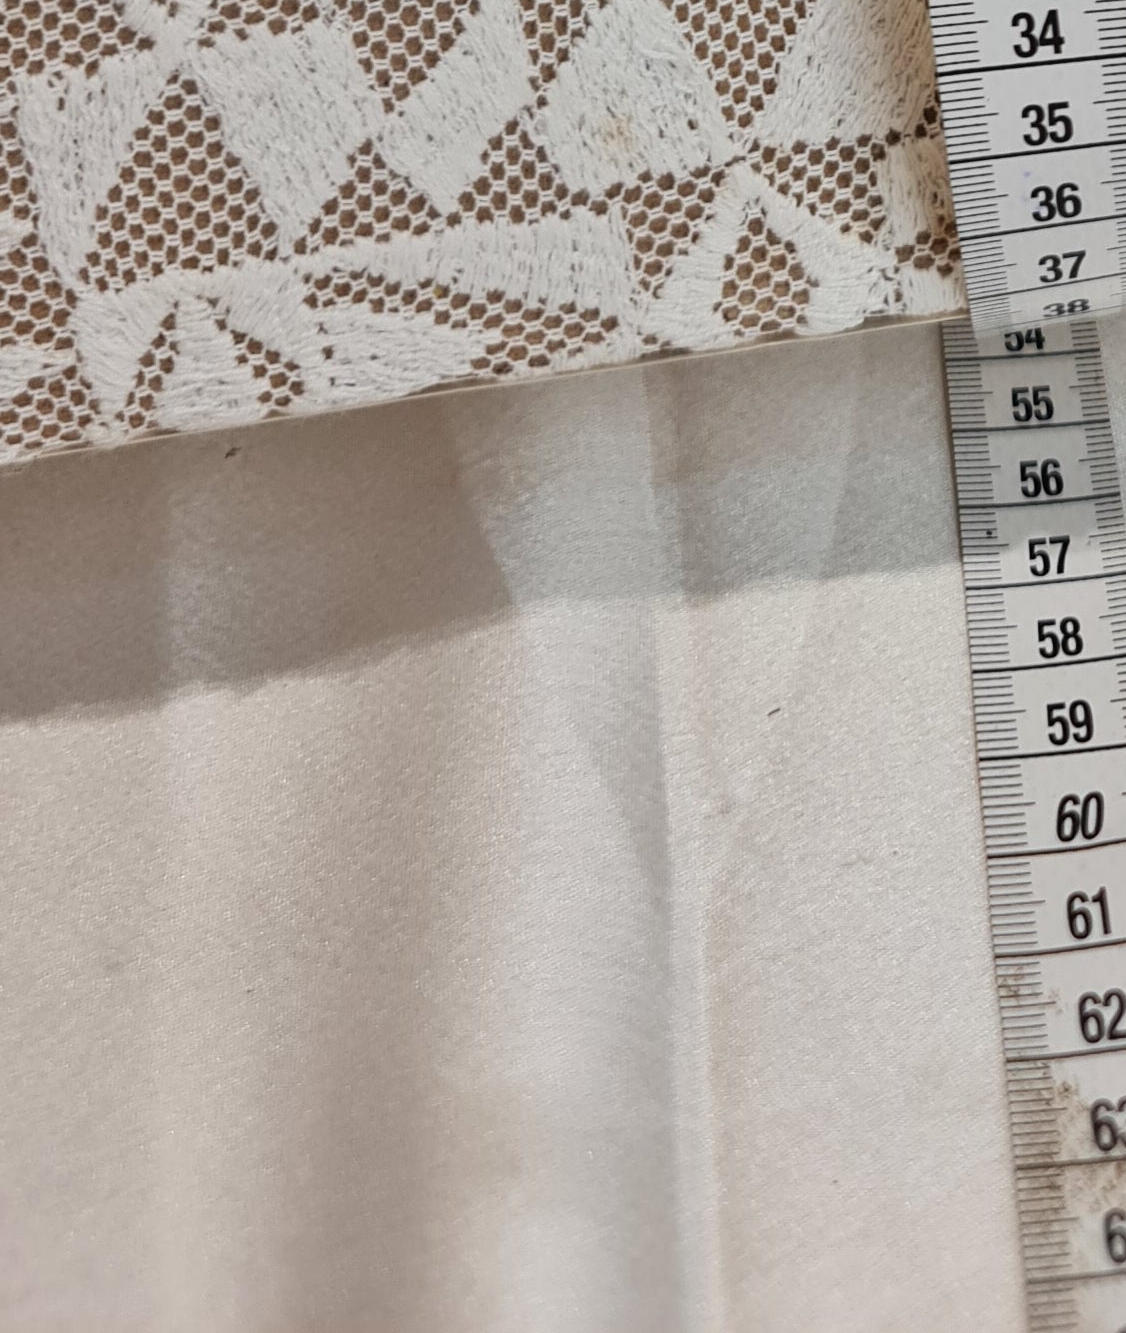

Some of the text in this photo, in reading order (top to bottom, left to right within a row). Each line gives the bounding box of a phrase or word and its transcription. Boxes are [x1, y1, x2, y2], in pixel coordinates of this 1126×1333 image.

[1012, 10, 1064, 58] 34
[1022, 102, 1073, 146] 35
[1031, 183, 1081, 222] 36
[1039, 251, 1085, 282] 37
[1042, 298, 1091, 318] 38
[1012, 386, 1053, 422] 55
[1020, 460, 1063, 498] 56
[1029, 536, 1070, 576] 57
[1038, 618, 1083, 658] 58
[1047, 700, 1093, 745] 59
[1057, 792, 1103, 842] 60
[1067, 888, 1111, 940] 61
